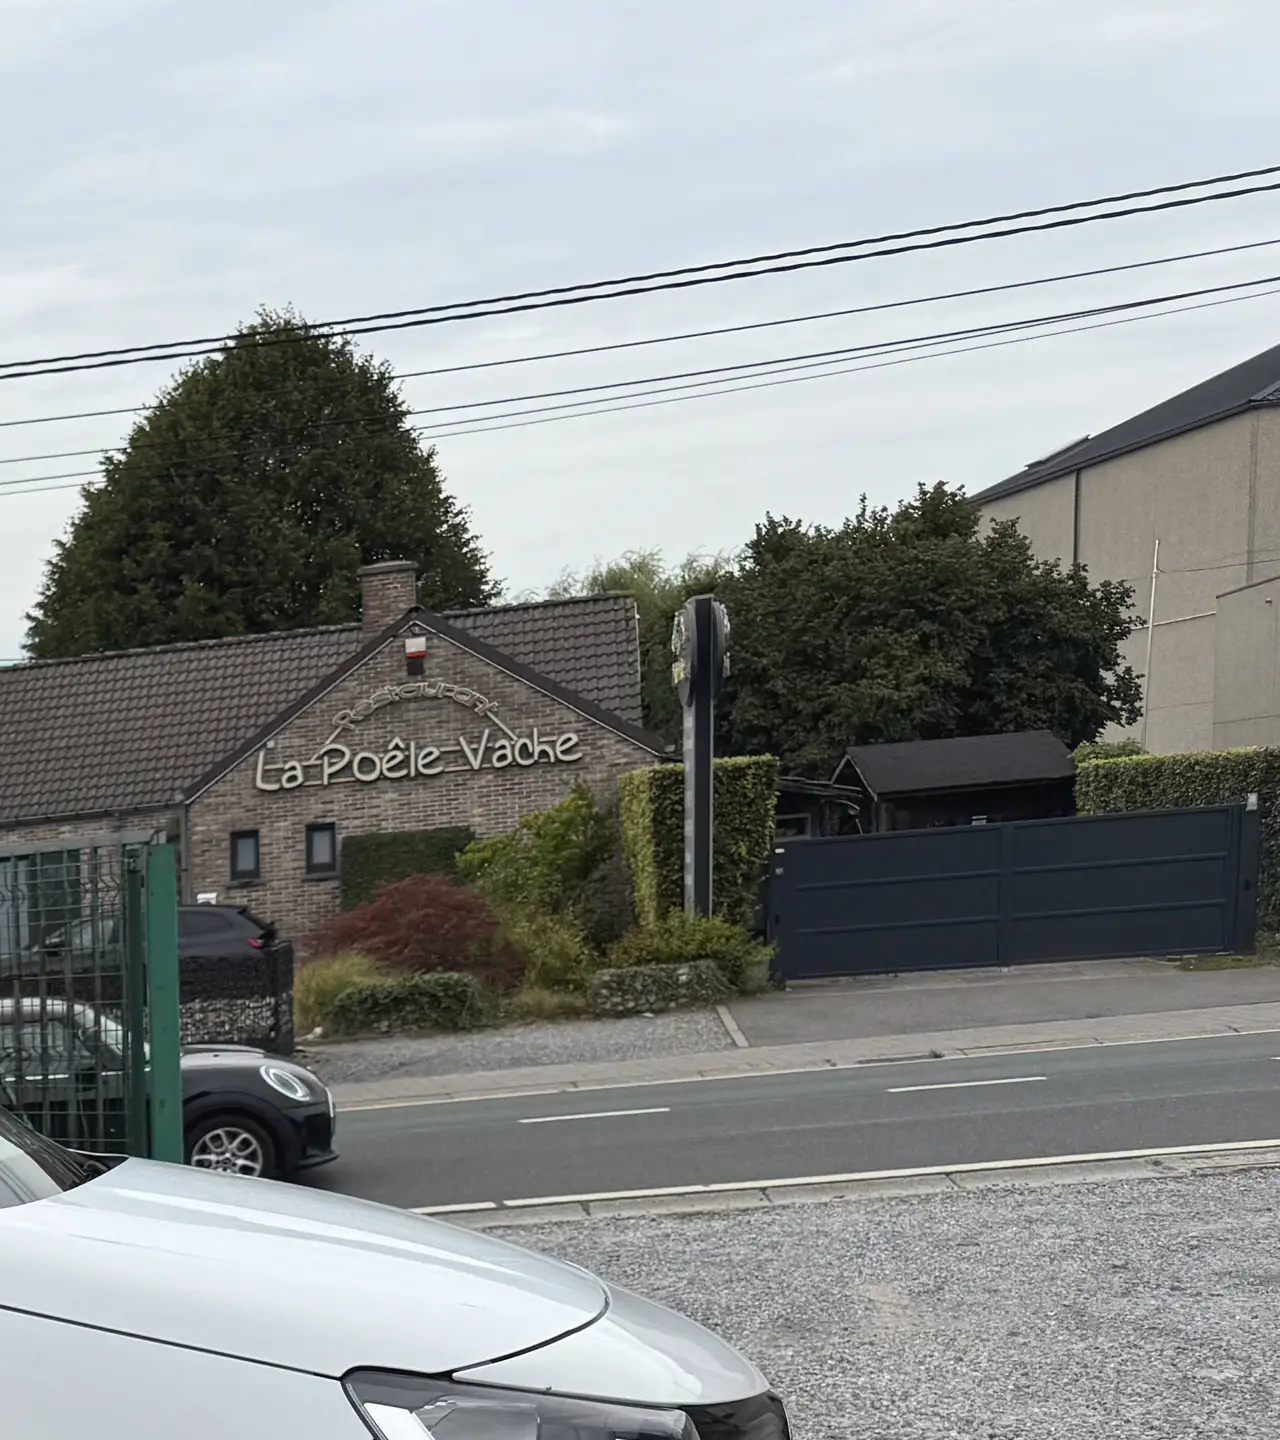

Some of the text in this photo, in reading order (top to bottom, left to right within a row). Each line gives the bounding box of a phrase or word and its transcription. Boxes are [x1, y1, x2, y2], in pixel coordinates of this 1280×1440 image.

[255, 727, 583, 791] La Poêle Vache
